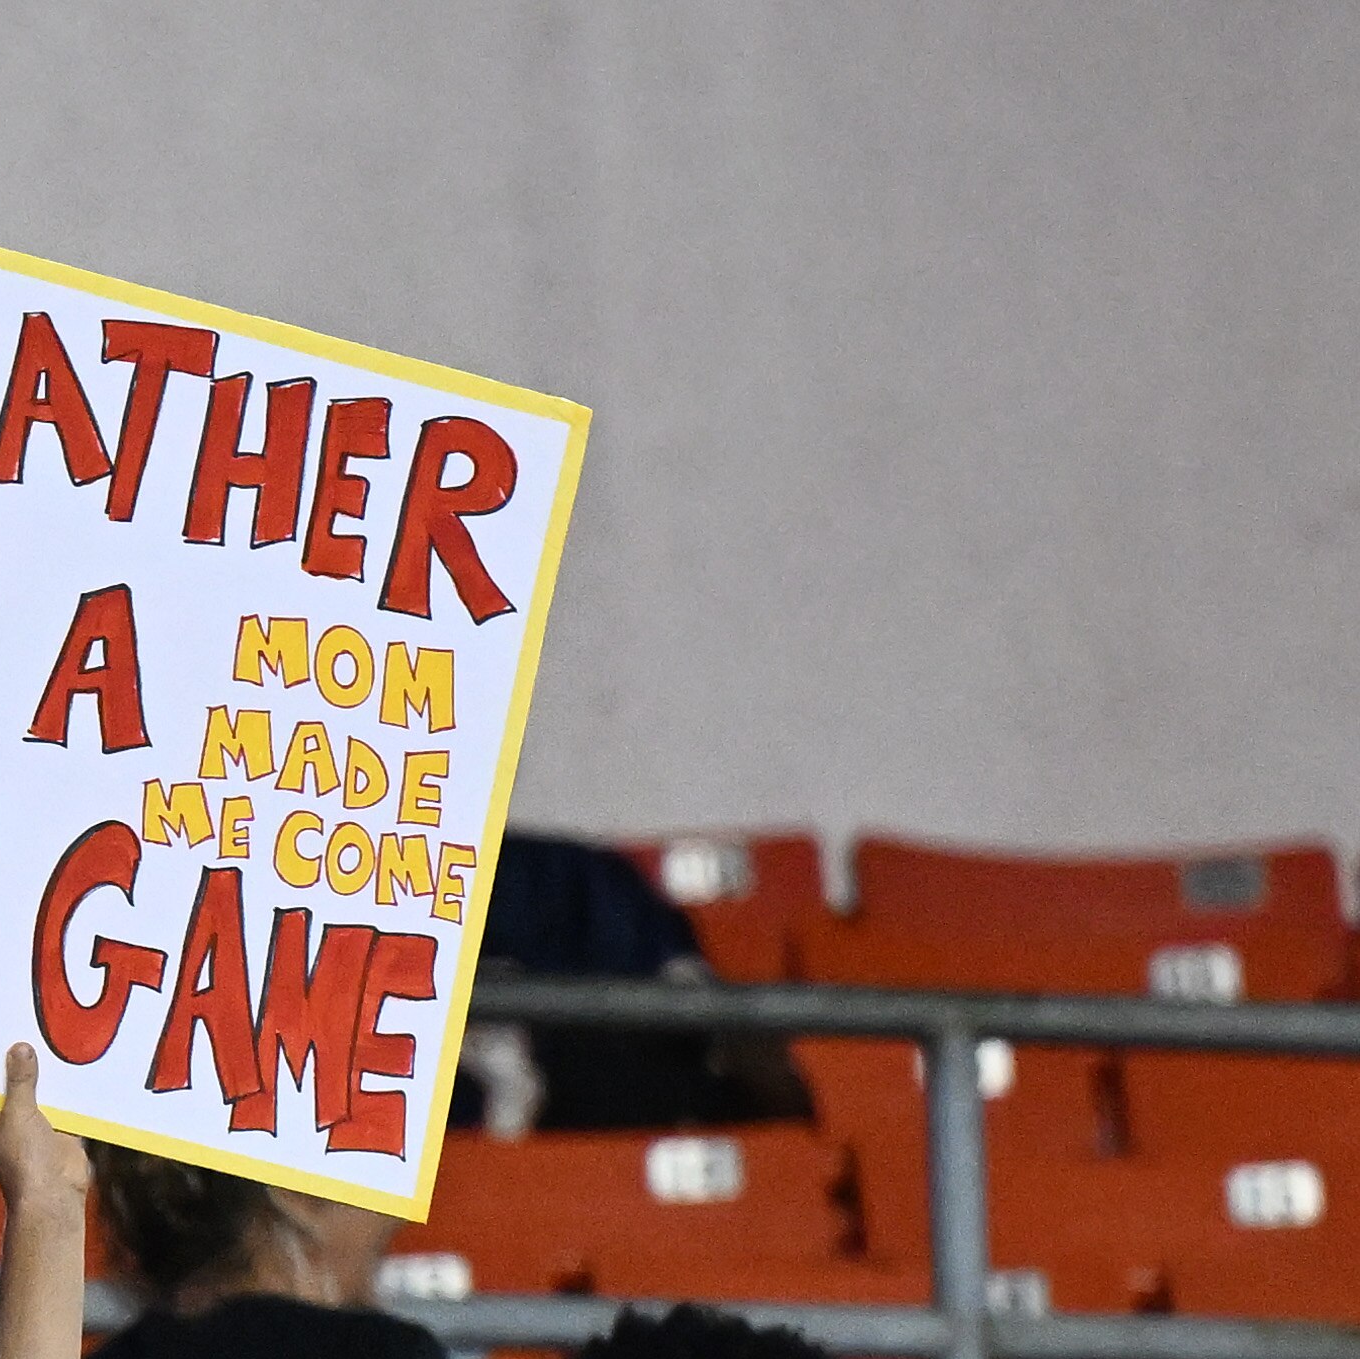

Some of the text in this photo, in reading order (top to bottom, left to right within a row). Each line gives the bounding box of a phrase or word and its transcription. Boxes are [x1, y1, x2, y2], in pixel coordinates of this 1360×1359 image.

[22, 584, 152, 754] A
[233, 614, 456, 733] MOM
[198, 705, 450, 827] MADE
[141, 778, 478, 924] ME COME
[31, 819, 438, 1161] GAME
